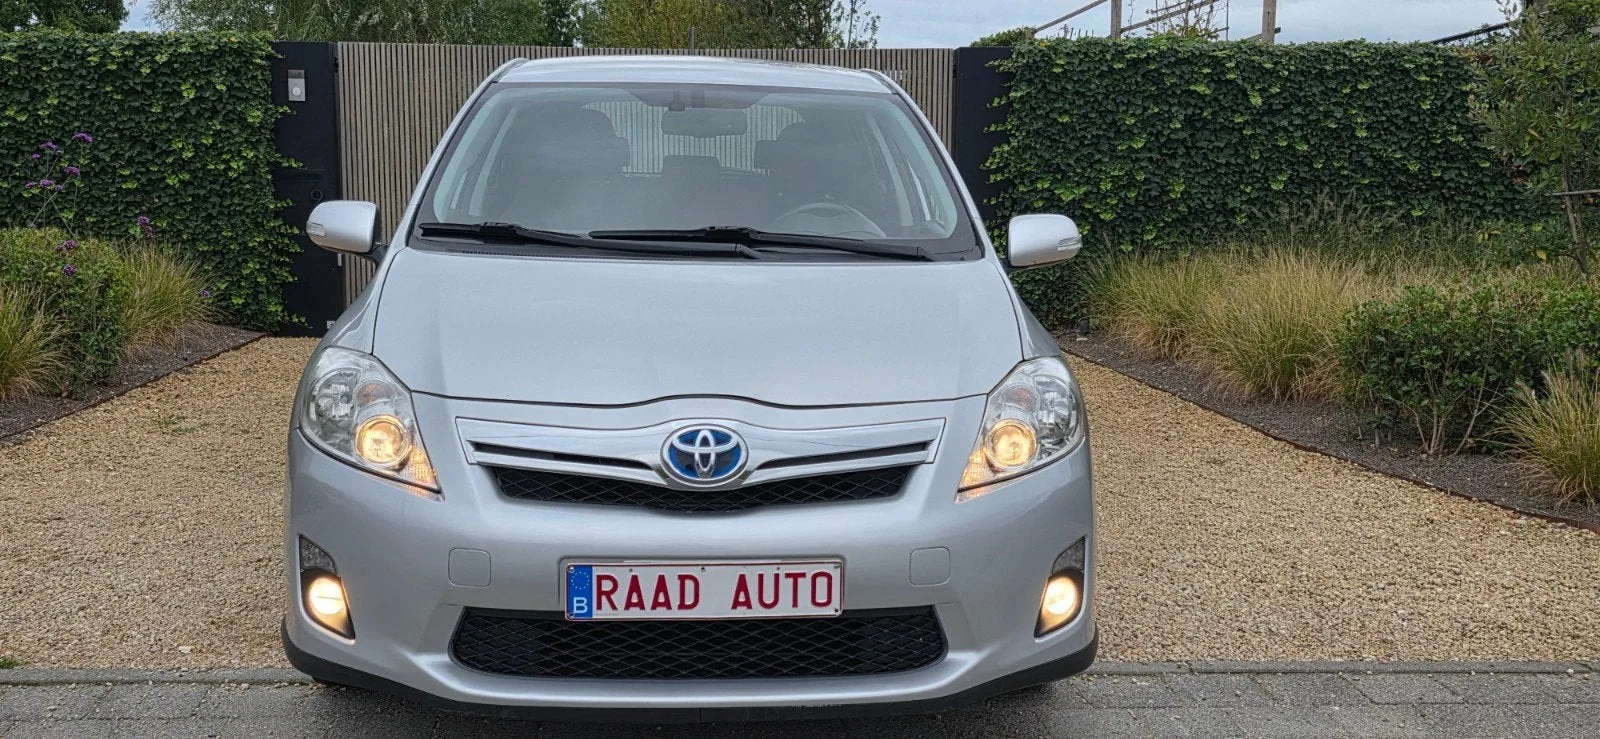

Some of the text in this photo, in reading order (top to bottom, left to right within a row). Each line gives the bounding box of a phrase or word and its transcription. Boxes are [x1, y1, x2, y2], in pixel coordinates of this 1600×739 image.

[573, 596, 589, 614] B
[595, 571, 834, 611] RAAD AUTO
